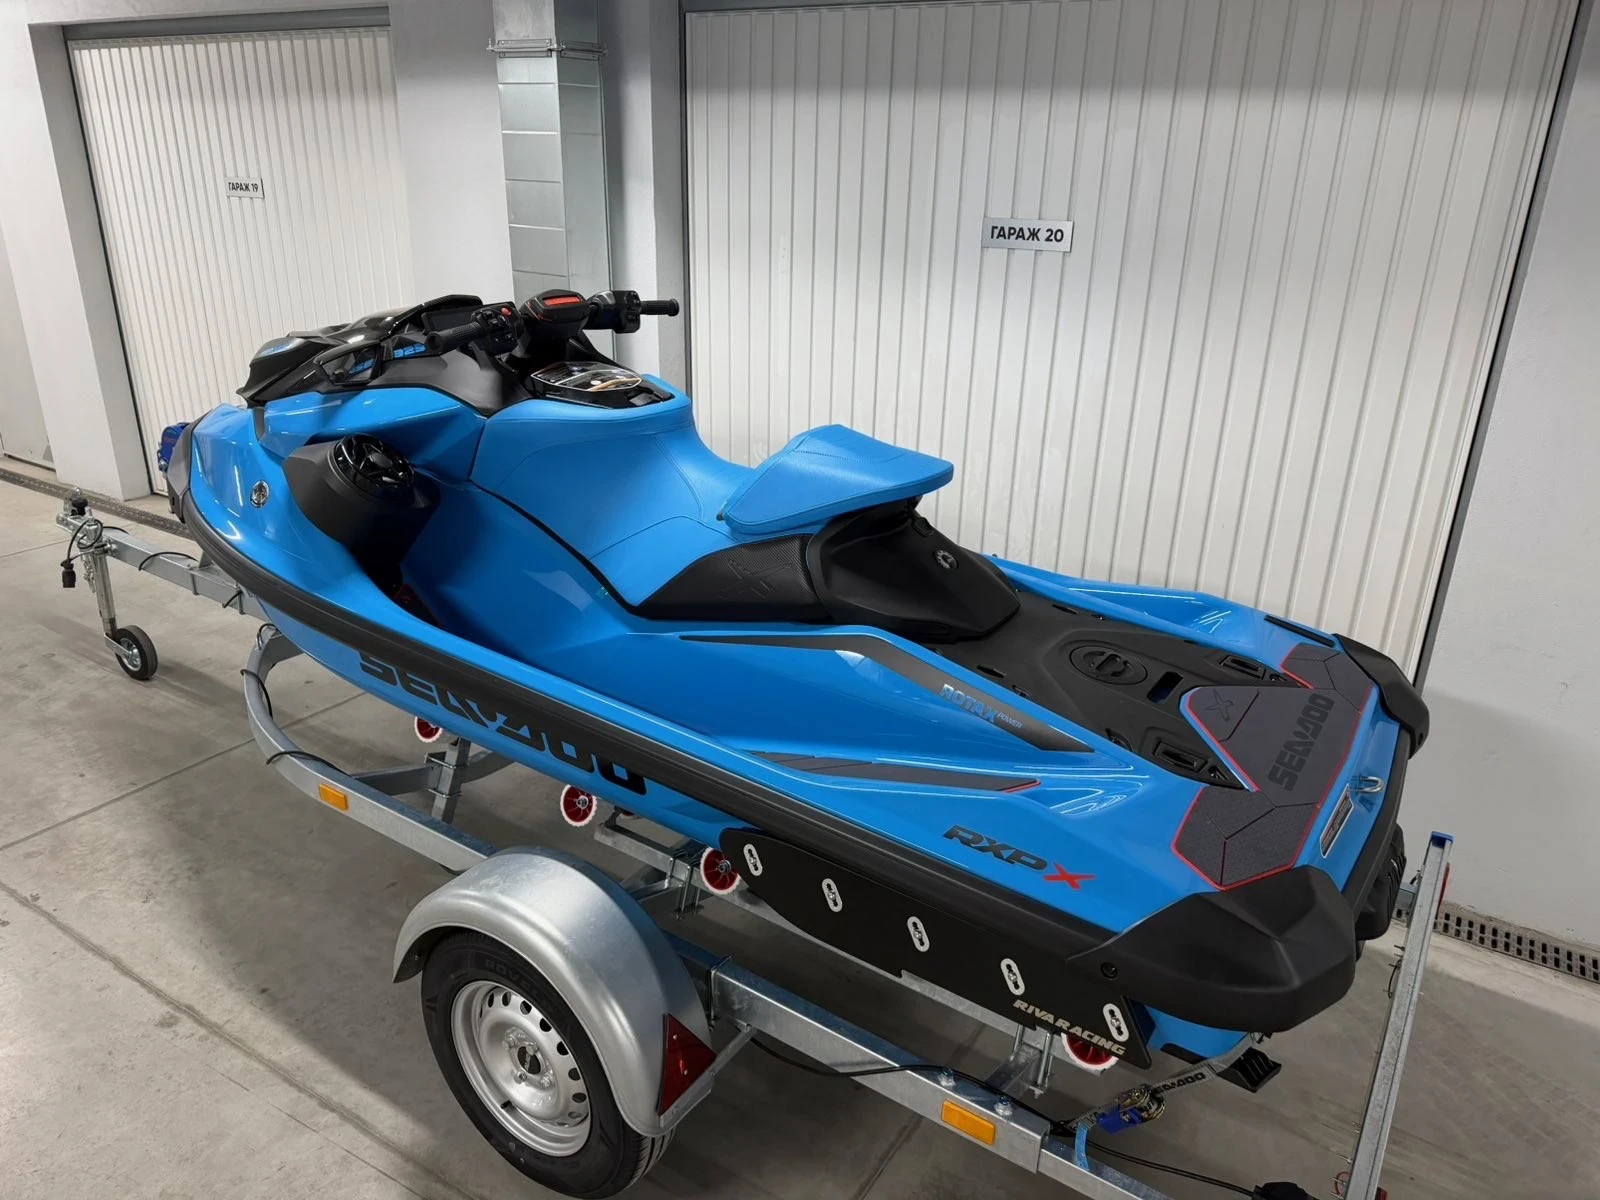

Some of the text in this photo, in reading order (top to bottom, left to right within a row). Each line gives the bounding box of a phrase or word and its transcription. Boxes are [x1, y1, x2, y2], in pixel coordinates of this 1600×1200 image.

[228, 182, 259, 192] ГАРАЖ 19
[990, 226, 1064, 242] ГАРАЖ 20
[940, 683, 1023, 729] ROTAX POWER
[1013, 999, 1127, 1055] RIVA RACING
